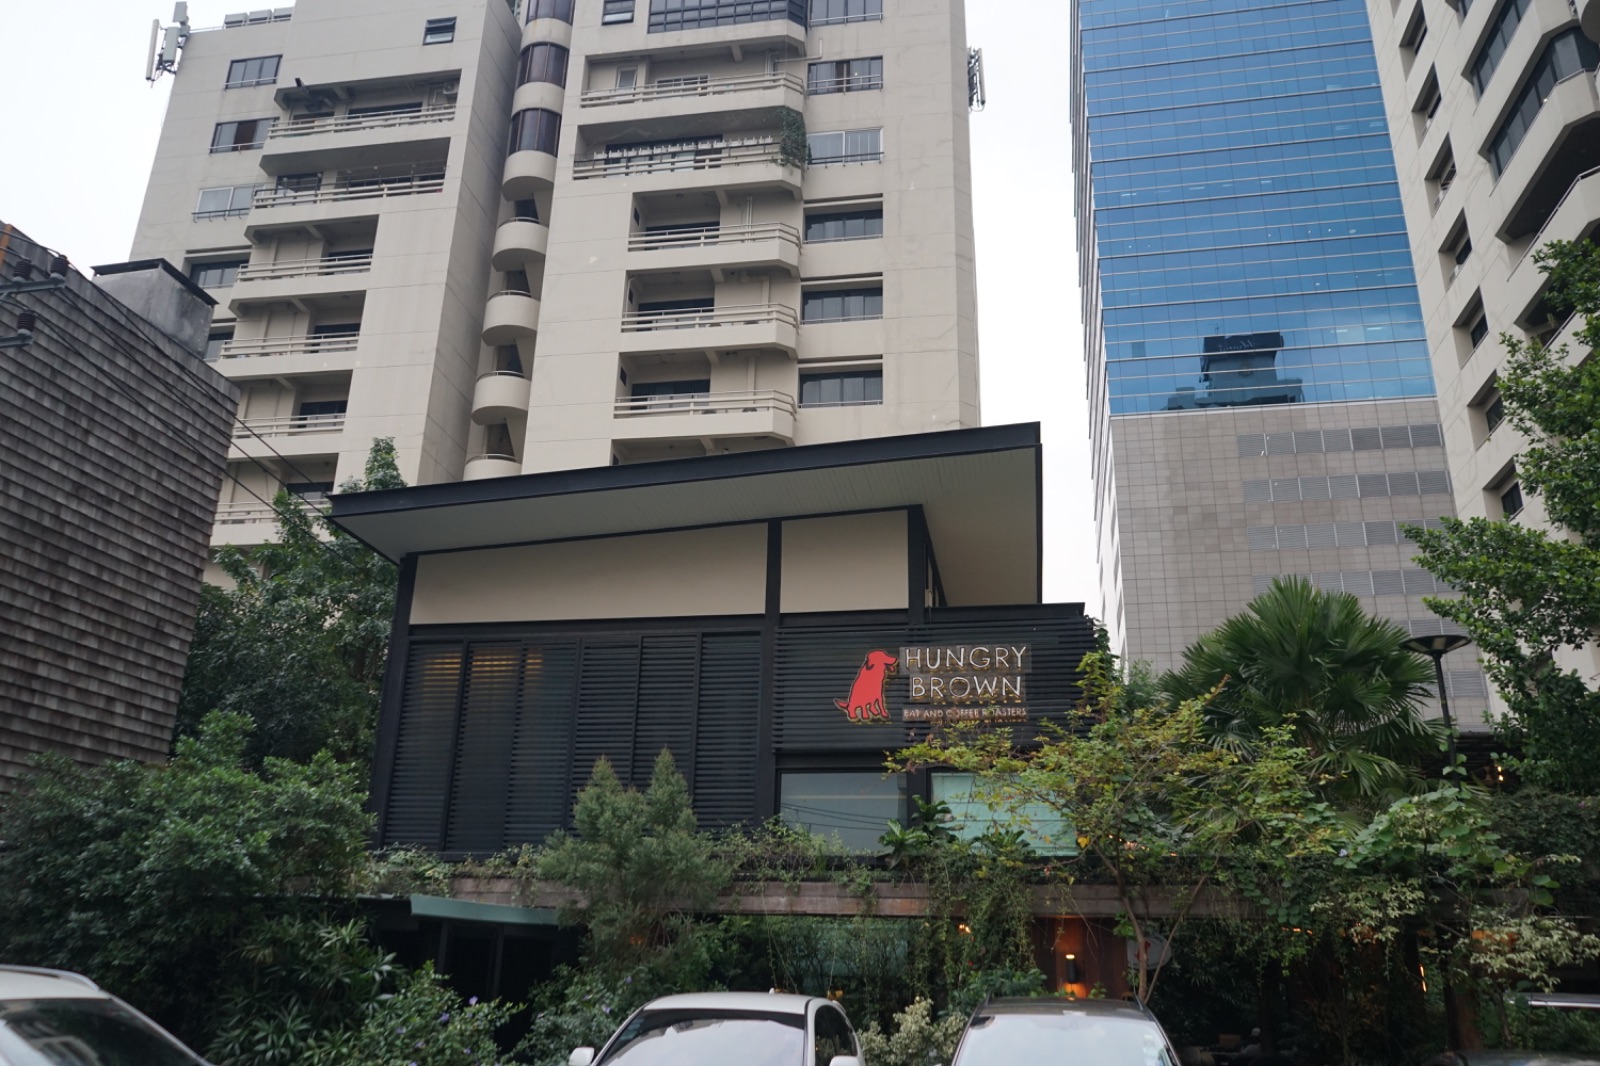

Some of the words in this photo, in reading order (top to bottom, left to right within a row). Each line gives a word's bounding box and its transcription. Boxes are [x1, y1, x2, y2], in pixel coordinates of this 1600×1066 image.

[905, 646, 1027, 669] HUNGRY
[911, 676, 1022, 698] BROWN
[903, 709, 921, 718] EAT
[923, 708, 943, 718] AND
